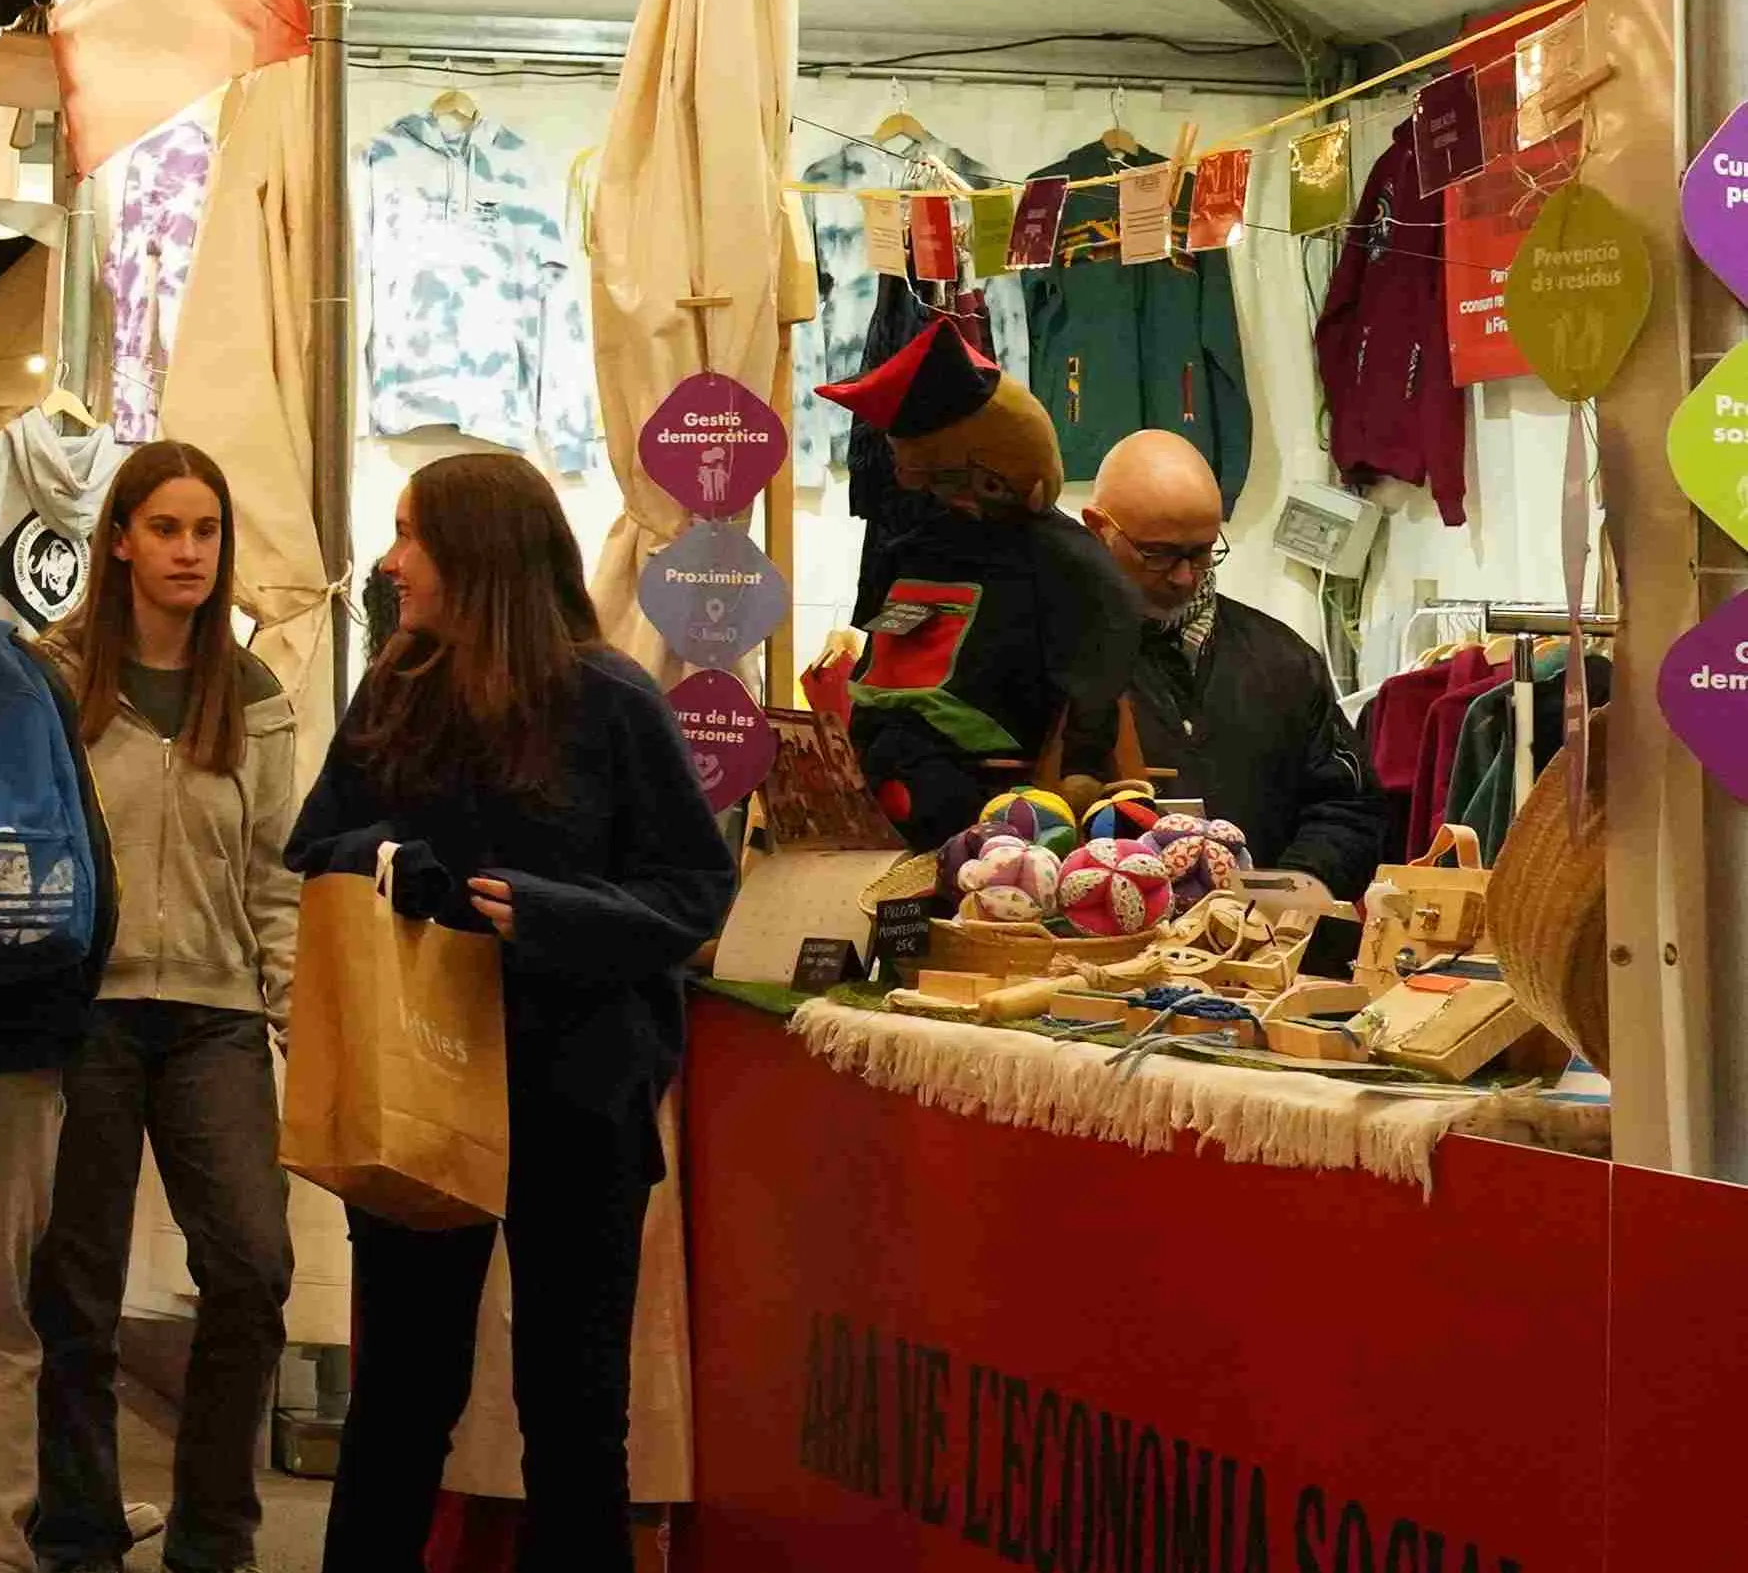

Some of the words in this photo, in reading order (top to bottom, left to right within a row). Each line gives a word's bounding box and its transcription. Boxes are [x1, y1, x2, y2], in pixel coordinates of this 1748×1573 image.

[1554, 267, 1622, 290] residus
[1715, 394, 1748, 417] Pr
[682, 411, 742, 427] Gestió
[656, 428, 769, 443] democràtica
[664, 567, 763, 586] Proximitat
[673, 710, 701, 724] ura
[705, 709, 727, 725] de
[731, 710, 755, 728] les
[681, 728, 745, 744] ersones
[801, 1311, 881, 1500] ARA
[896, 1336, 951, 1524] VE
